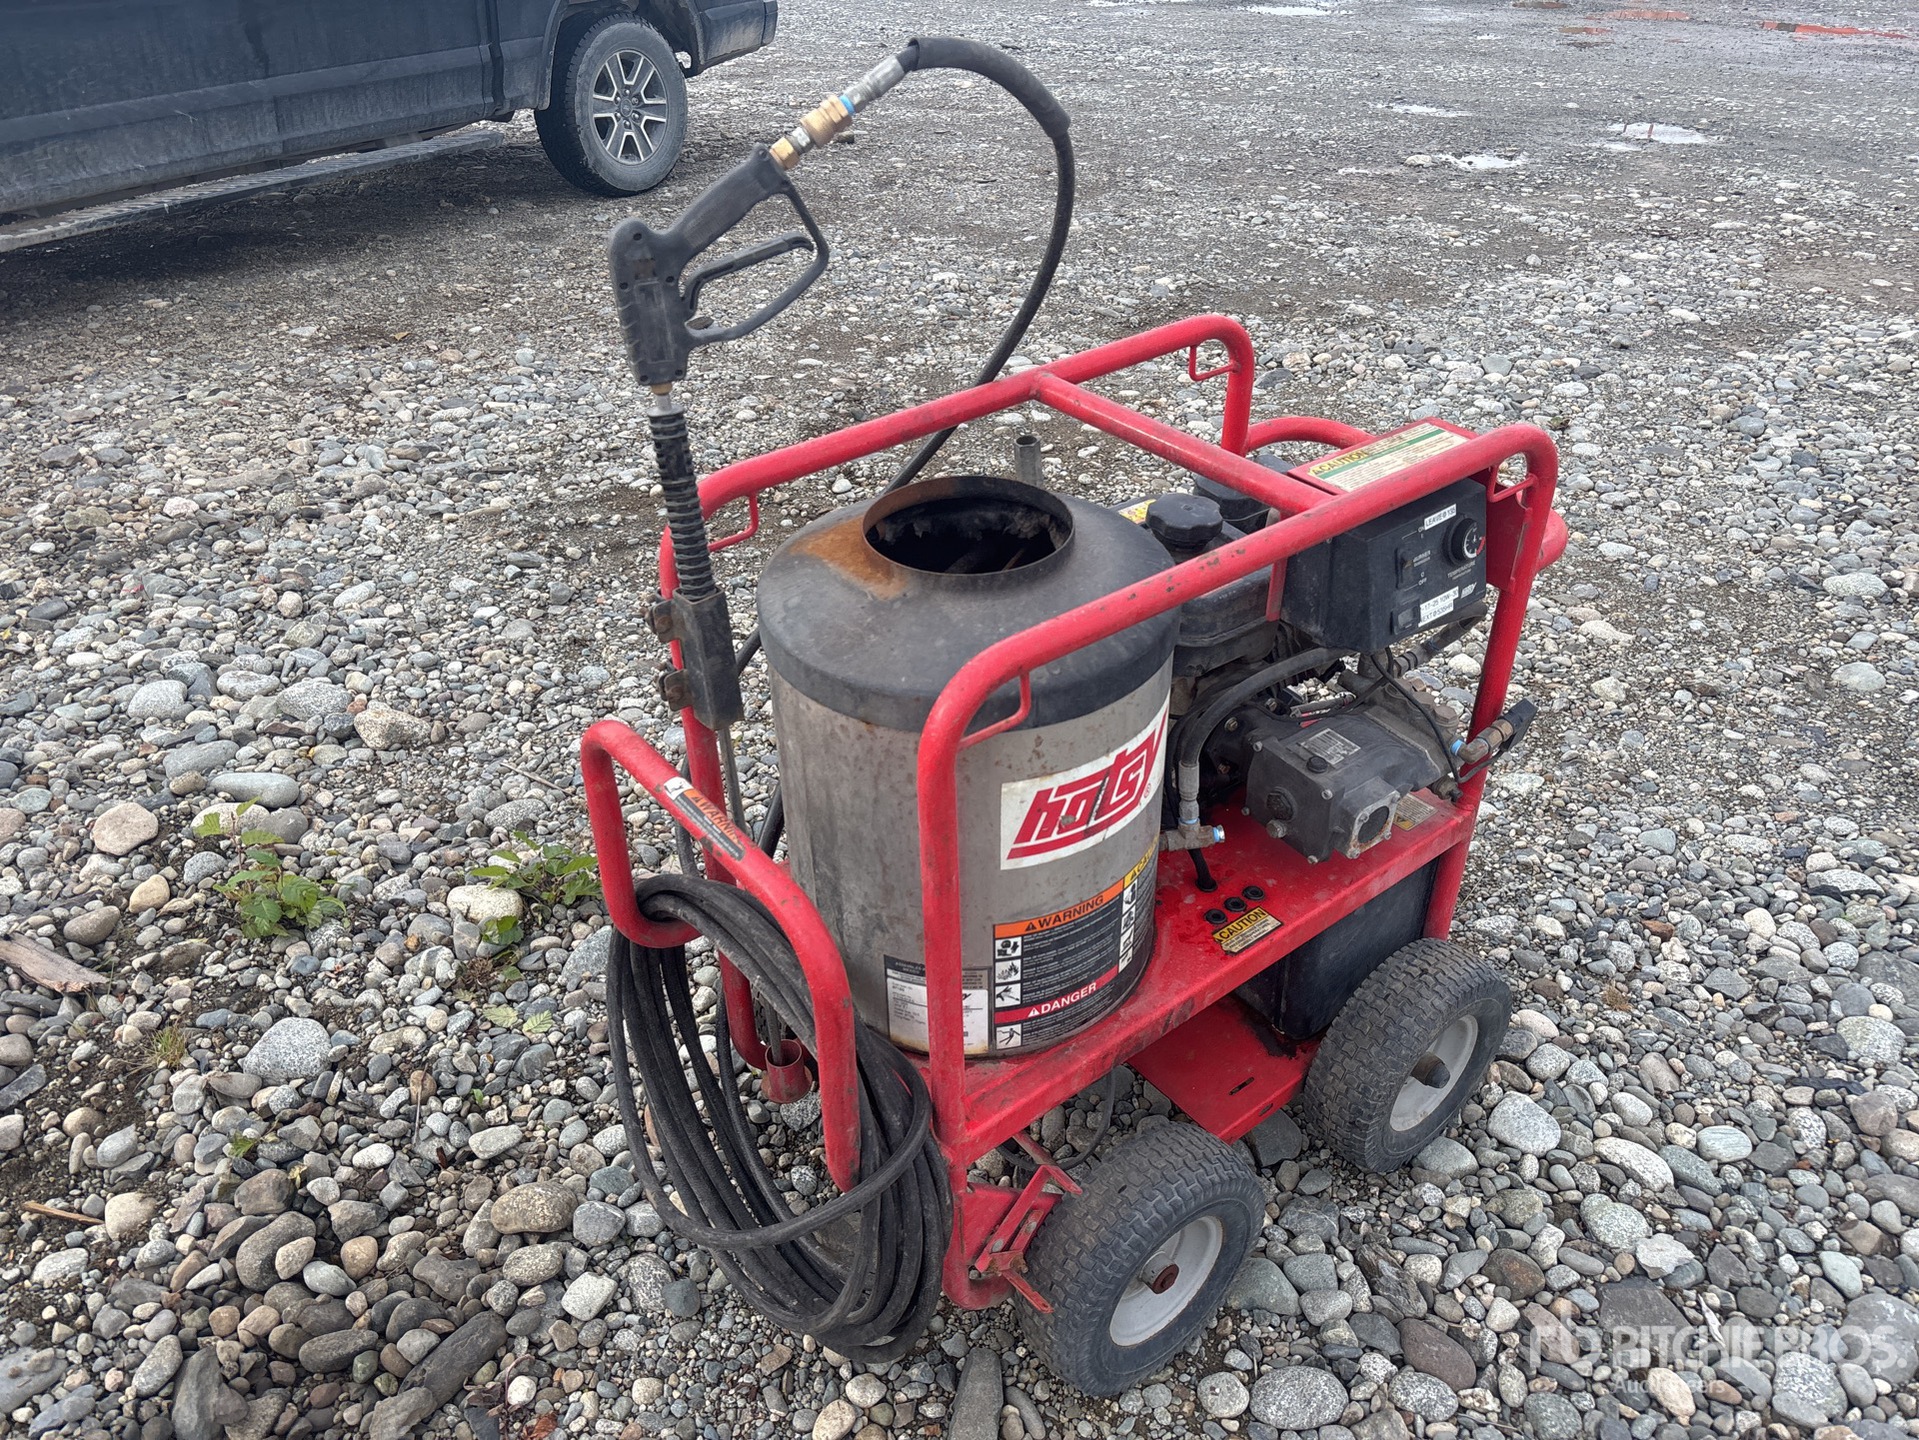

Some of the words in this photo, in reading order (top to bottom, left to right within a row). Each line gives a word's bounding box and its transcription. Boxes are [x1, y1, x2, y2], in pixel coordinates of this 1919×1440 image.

[1320, 449, 1370, 472] CAUTION
[698, 800, 738, 842] WARNI
[1038, 895, 1104, 929] WARNING
[1218, 908, 1267, 940] CAUTION
[1041, 982, 1098, 1015] DANGER
